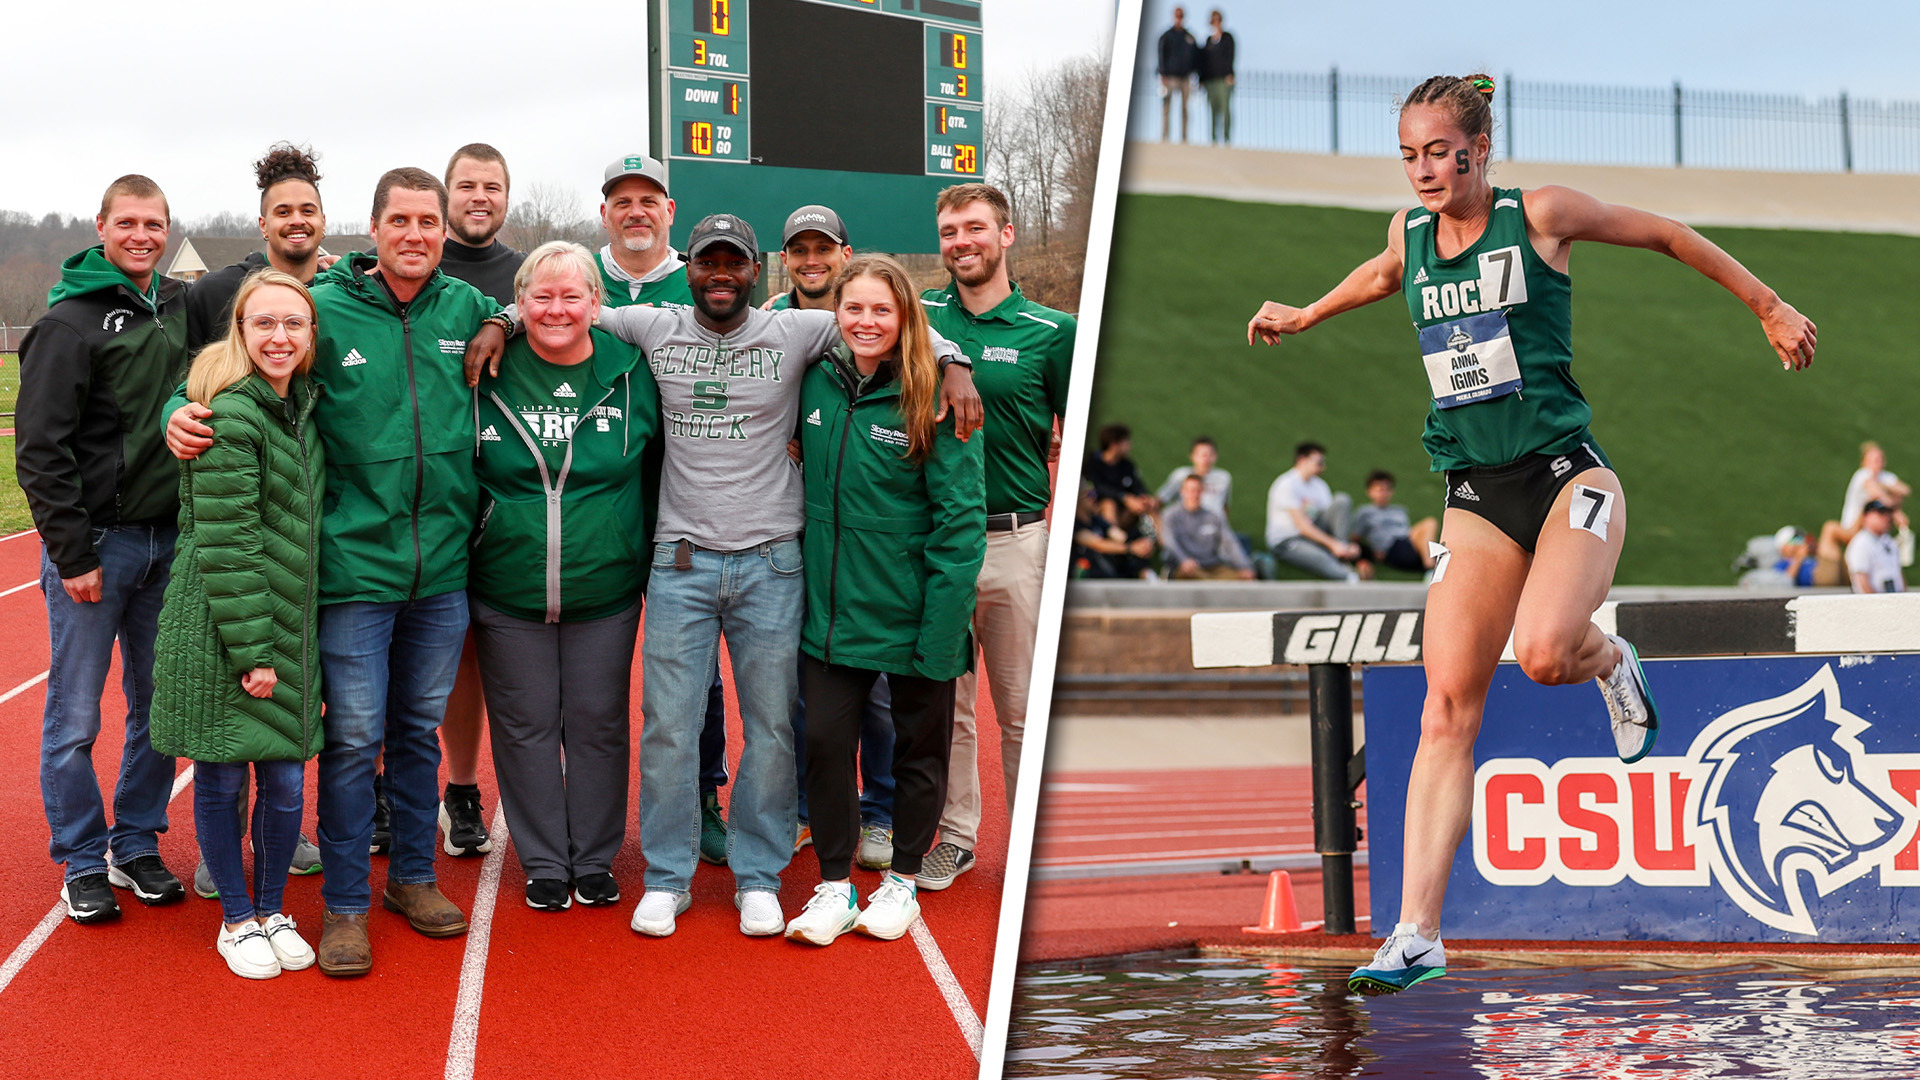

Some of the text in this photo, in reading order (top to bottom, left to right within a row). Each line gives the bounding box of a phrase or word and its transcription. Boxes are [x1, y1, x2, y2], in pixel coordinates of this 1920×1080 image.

[711, 0, 730, 36] 0
[693, 39, 729, 68] 3 TOL
[952, 33, 967, 70] 0
[685, 83, 739, 115] DOWN 1
[940, 74, 968, 97] TOL 3
[716, 126, 732, 140] TO
[940, 106, 968, 136] 1 QTR.
[691, 121, 712, 156] 10
[716, 140, 732, 155] GO
[930, 144, 953, 157] BALL
[623, 156, 644, 172] S
[940, 157, 953, 170] ON
[954, 143, 977, 173] 20
[1455, 148, 1471, 176] S
[1488, 250, 1514, 304] 7
[341, 358, 367, 367] adidas
[650, 346, 785, 383] SLIPPERY
[1451, 352, 1480, 371] ANNA
[1450, 367, 1490, 391] IGIMS
[691, 380, 730, 411] S
[595, 418, 610, 432] S
[670, 411, 752, 441] ROCK
[1550, 455, 1573, 479] S
[1454, 490, 1480, 502] adidas
[1582, 488, 1606, 531] 7
[1284, 612, 1420, 664] GILL
[1484, 771, 1697, 872] CSU
